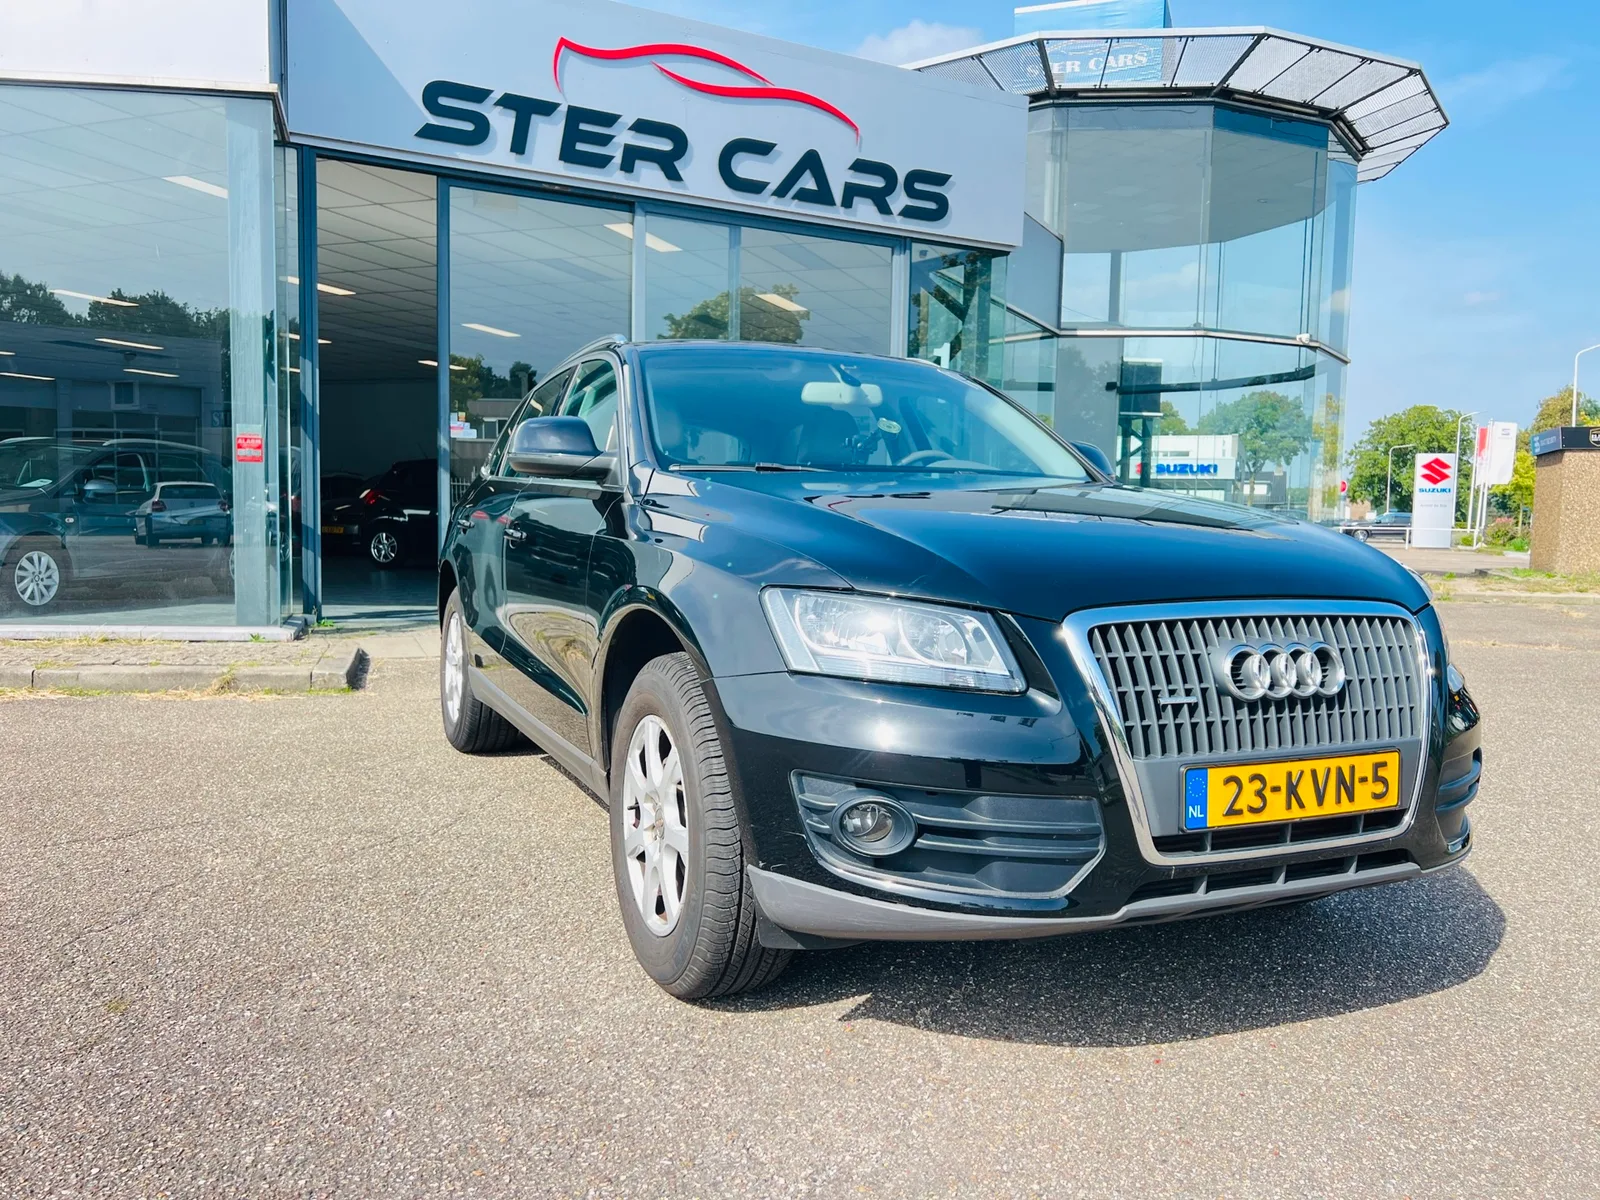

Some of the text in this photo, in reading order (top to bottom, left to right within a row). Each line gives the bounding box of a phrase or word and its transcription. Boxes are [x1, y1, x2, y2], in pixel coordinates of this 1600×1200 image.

[1026, 52, 1148, 77] SER CARS
[414, 79, 953, 221] STER CARS
[1155, 463, 1218, 474] SUZUKI
[1188, 762, 1389, 819] NL 23-KVN-5
